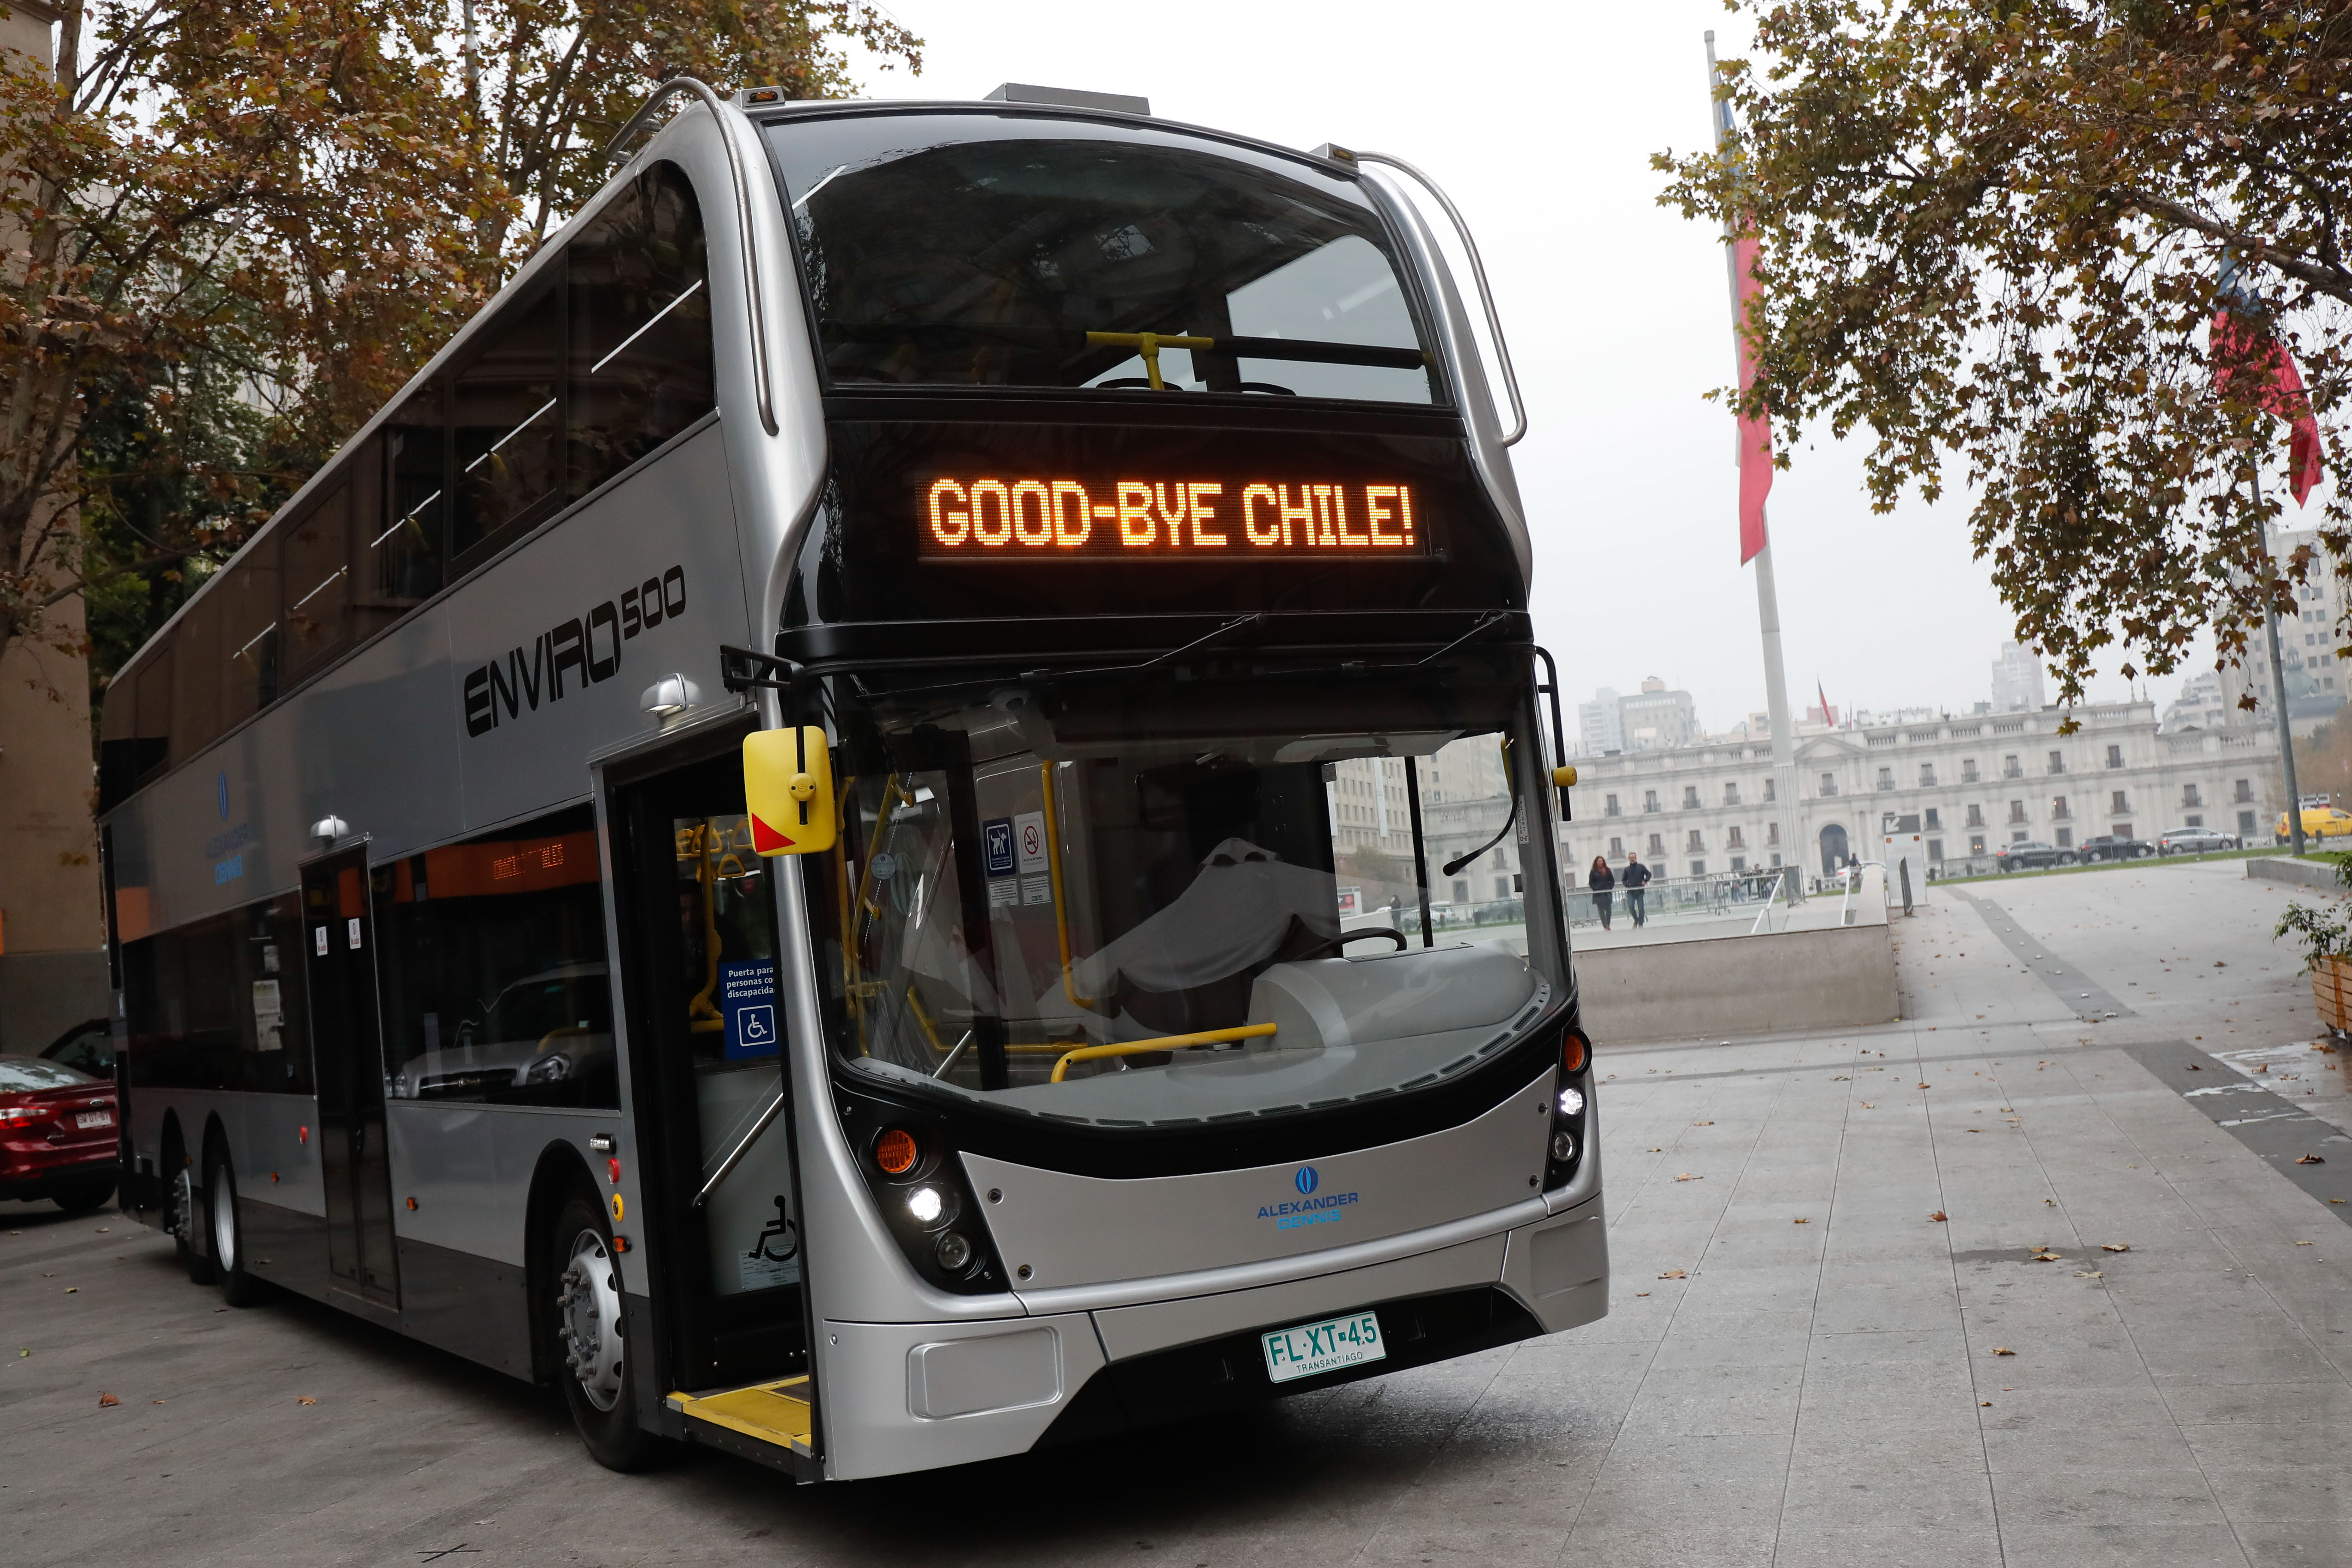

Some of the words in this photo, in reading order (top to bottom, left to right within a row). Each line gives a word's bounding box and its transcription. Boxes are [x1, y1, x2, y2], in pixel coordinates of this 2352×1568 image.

[929, 478, 1228, 546] GOOD-BYE
[1242, 483, 1414, 546] CHILE!
[729, 968, 754, 977] Puerta
[757, 967, 773, 976] para
[726, 977, 762, 989] personas
[727, 986, 775, 998] discapacida
[1257, 1192, 1359, 1219] ALEXANDER
[1278, 1209, 1341, 1230] DENNIS
[1296, 1351, 1363, 1373] TRANSANTIAGO
